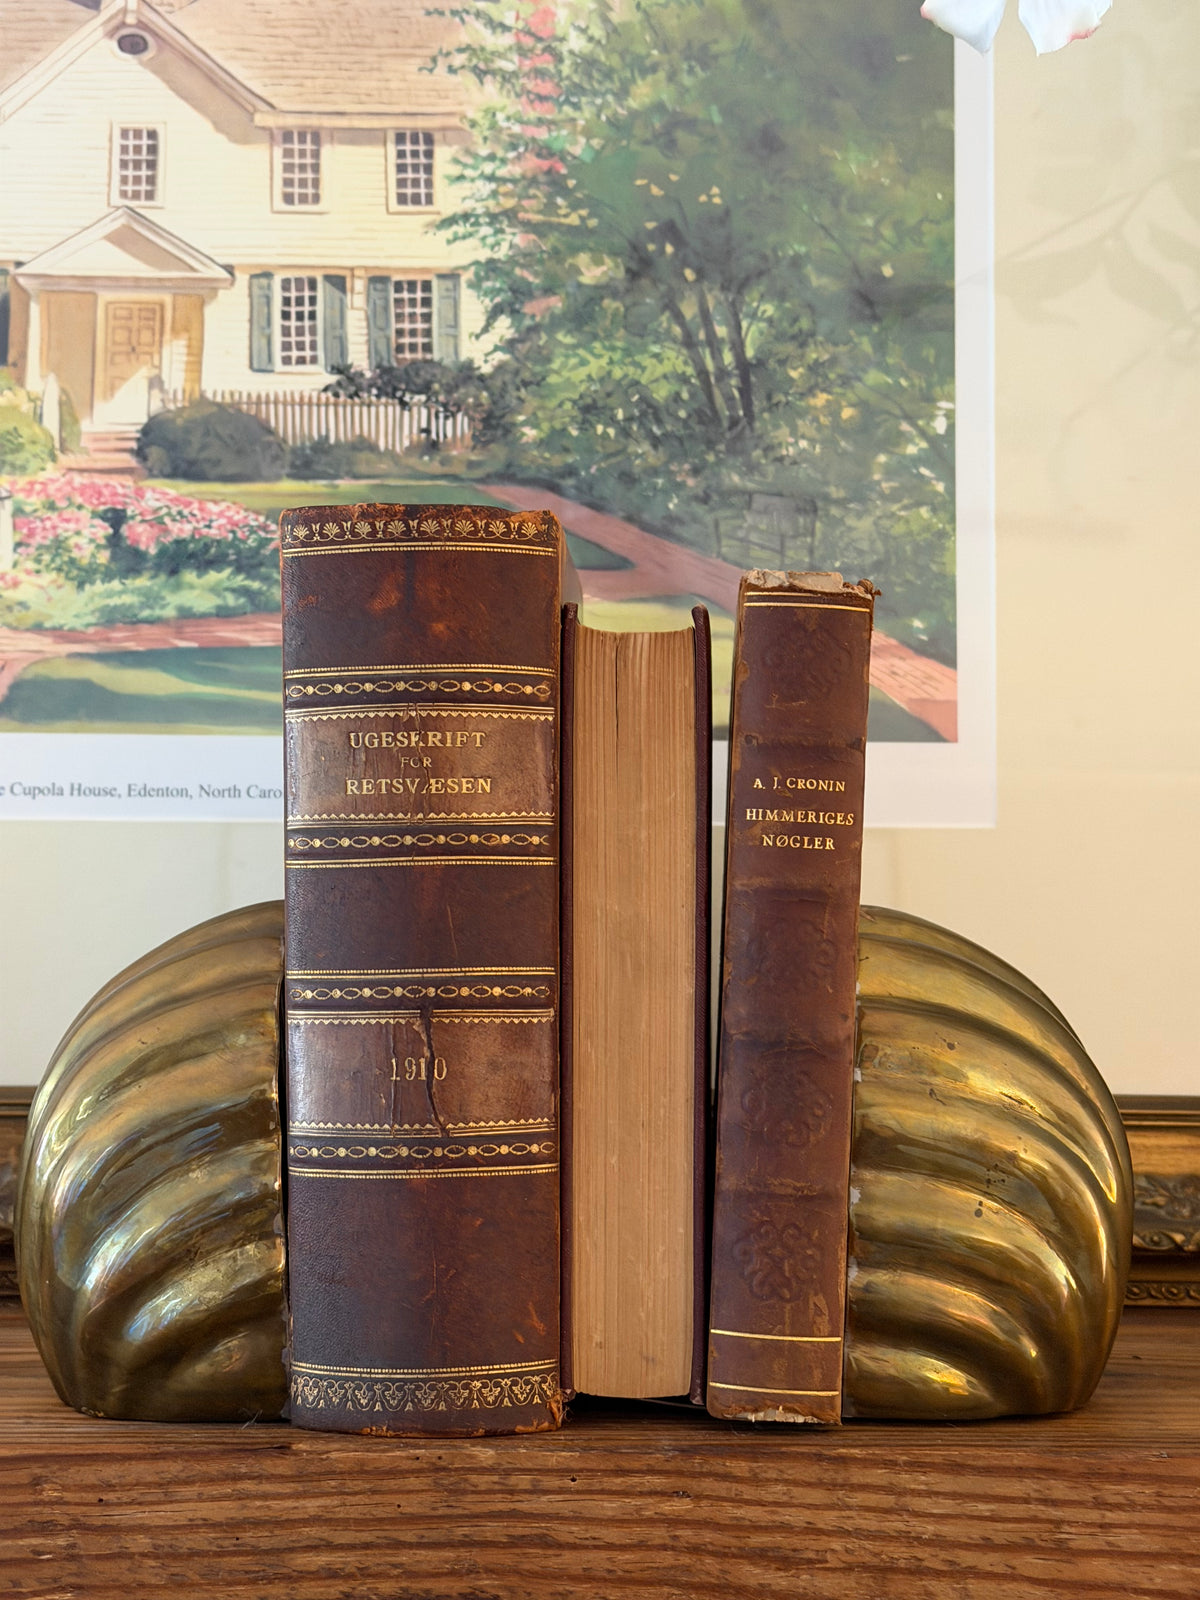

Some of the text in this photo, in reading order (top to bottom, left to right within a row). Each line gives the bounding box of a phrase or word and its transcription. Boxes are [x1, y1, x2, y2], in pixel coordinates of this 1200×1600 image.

[350, 730, 485, 749] UGESKRIFT
[401, 756, 432, 768] FOR
[10, 781, 64, 800] Cupola
[69, 783, 122, 798] House,
[127, 784, 193, 799] Edenton,
[199, 784, 241, 799] North
[346, 778, 491, 796] RETSVÆSEN
[753, 777, 846, 792] A. J. CRONIN
[745, 808, 855, 826] HIMMERIGES
[762, 834, 835, 850] NØGLER
[390, 1057, 447, 1080] 1910
